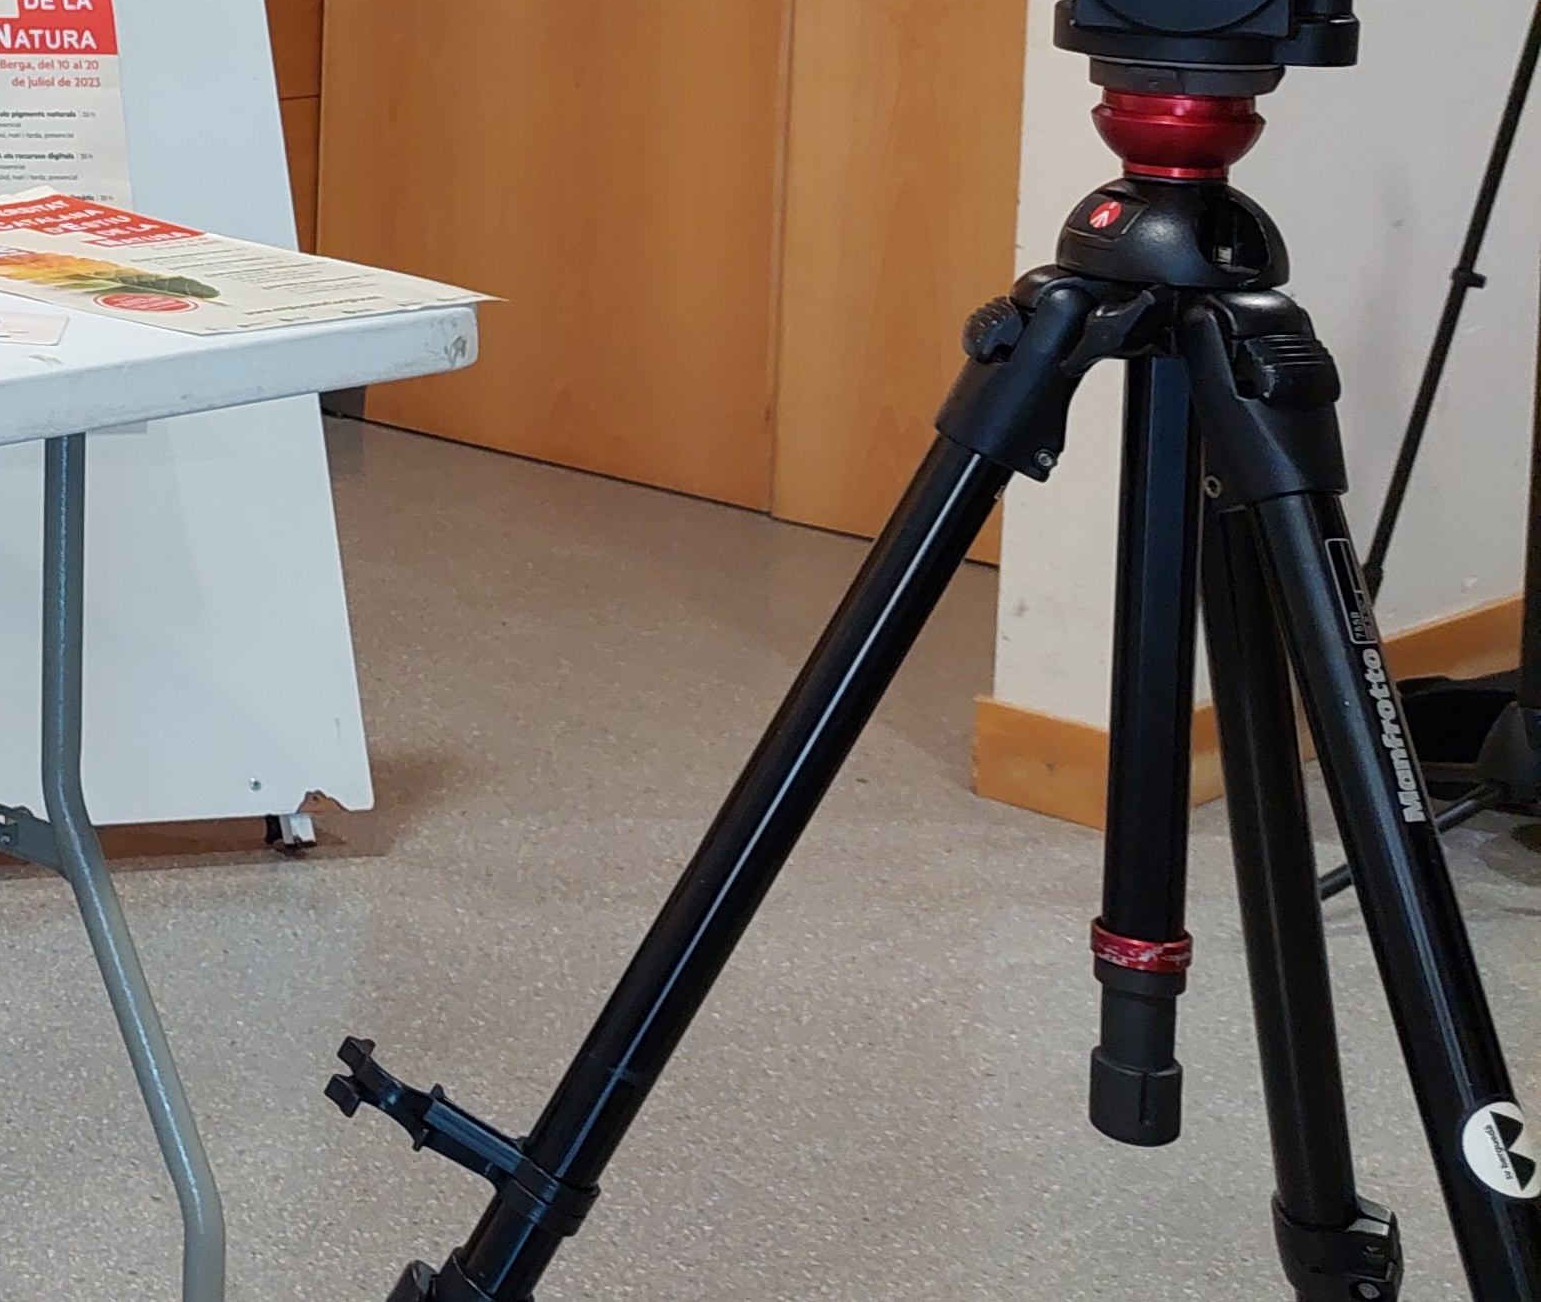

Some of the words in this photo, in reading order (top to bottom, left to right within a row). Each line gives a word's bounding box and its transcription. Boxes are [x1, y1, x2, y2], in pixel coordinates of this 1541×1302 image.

[0, 59, 35, 72] Berga,
[38, 59, 55, 70] del
[58, 60, 70, 70] 10
[72, 59, 82, 70] al
[86, 60, 99, 70] 20
[11, 77, 25, 87] de
[27, 77, 55, 89] juliol
[58, 77, 71, 87] de
[74, 77, 101, 88] 2023
[1362, 648, 1428, 824] Manfrotto
